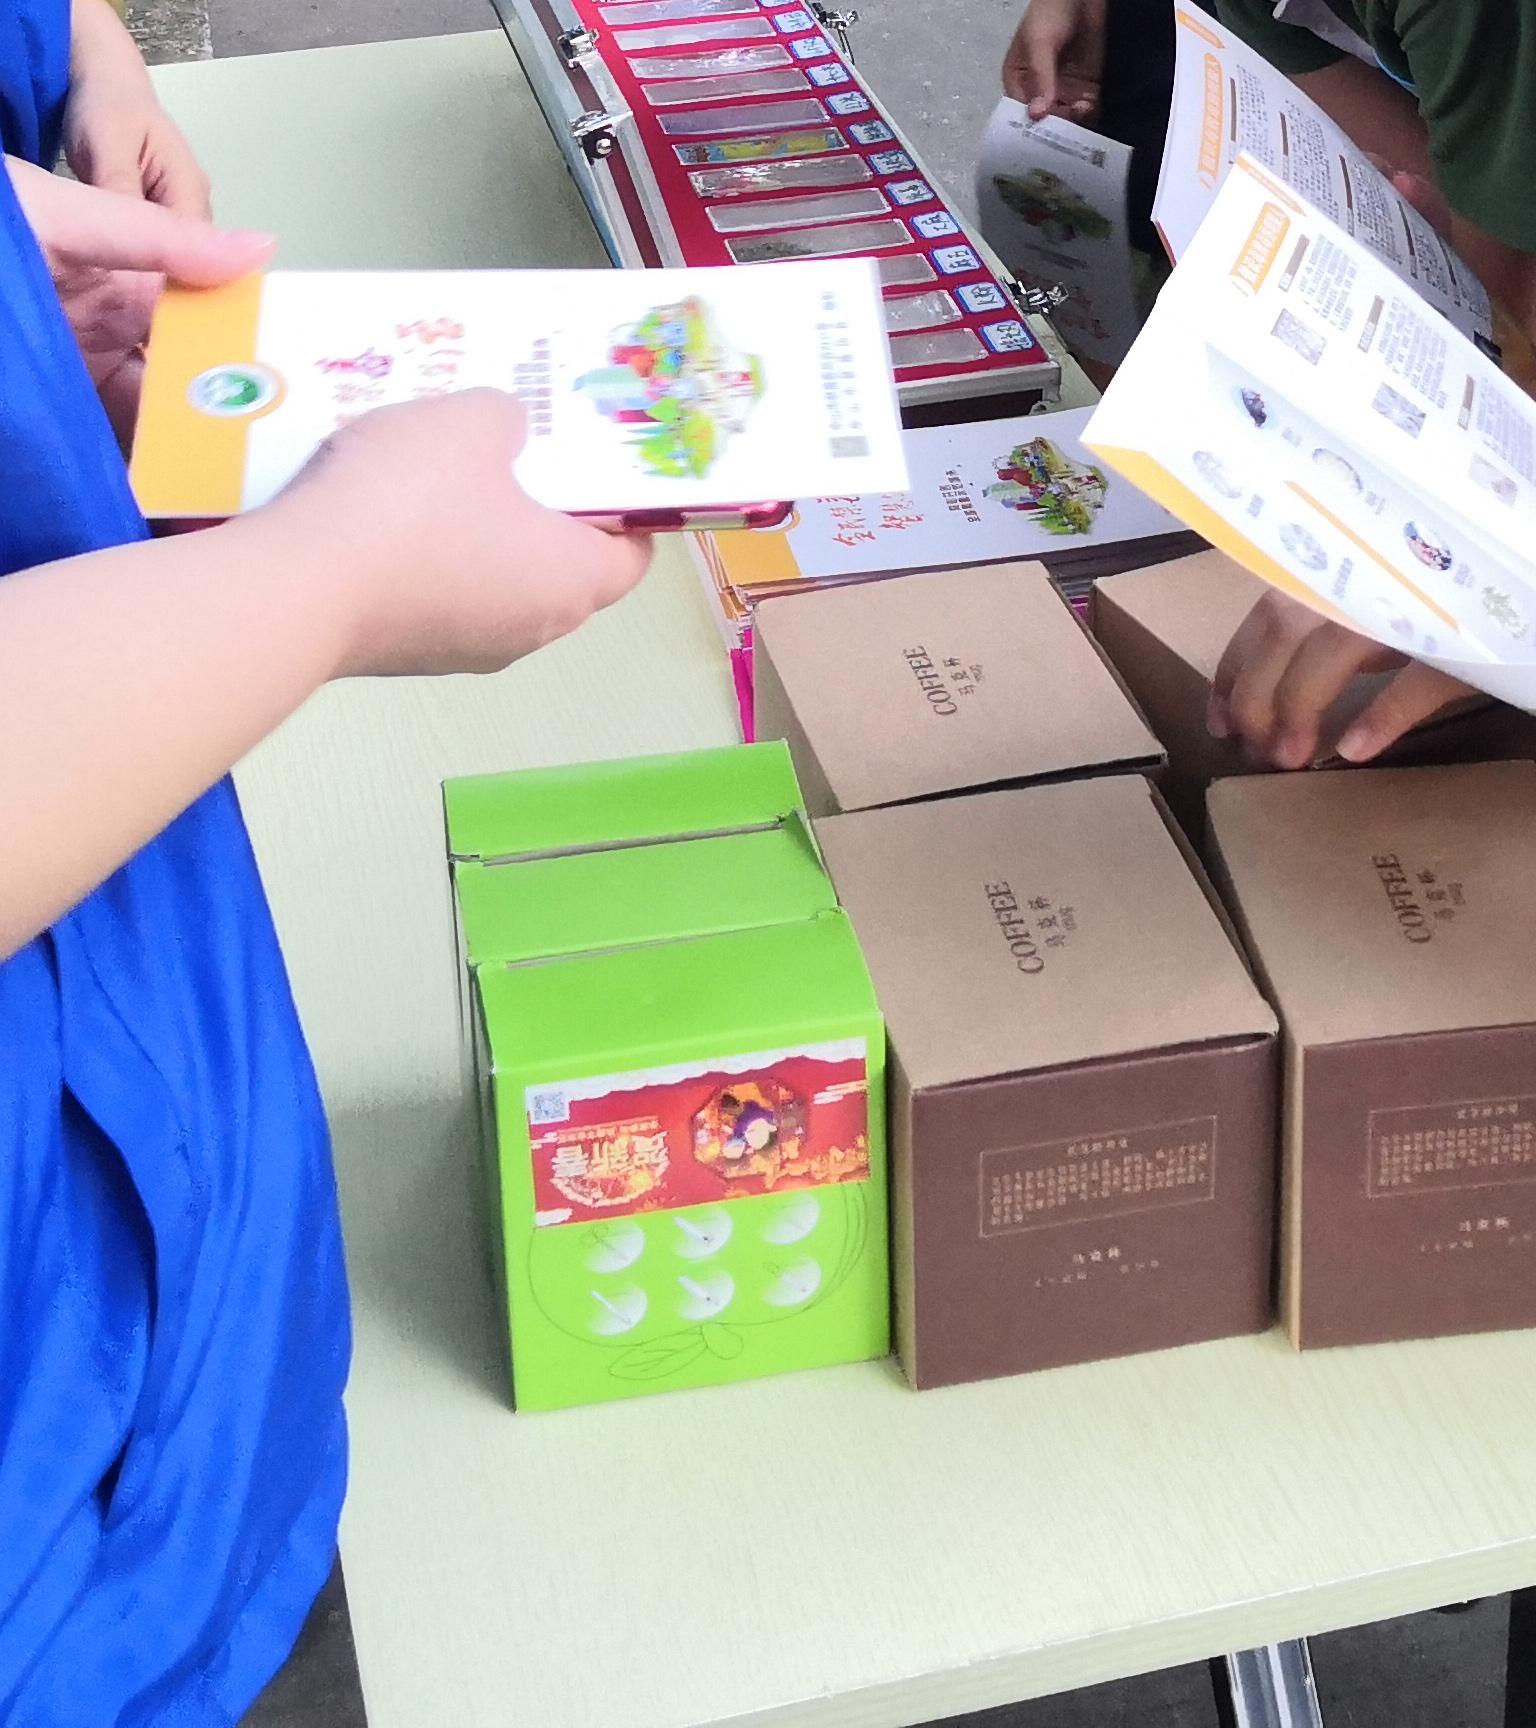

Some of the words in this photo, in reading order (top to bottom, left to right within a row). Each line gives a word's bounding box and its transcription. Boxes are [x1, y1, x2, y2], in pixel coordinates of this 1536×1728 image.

[904, 644, 958, 717] COFFEE
[985, 881, 1046, 975] COFFEE
[1372, 853, 1432, 945] COFFEE
[552, 1130, 671, 1177] 贺新春
